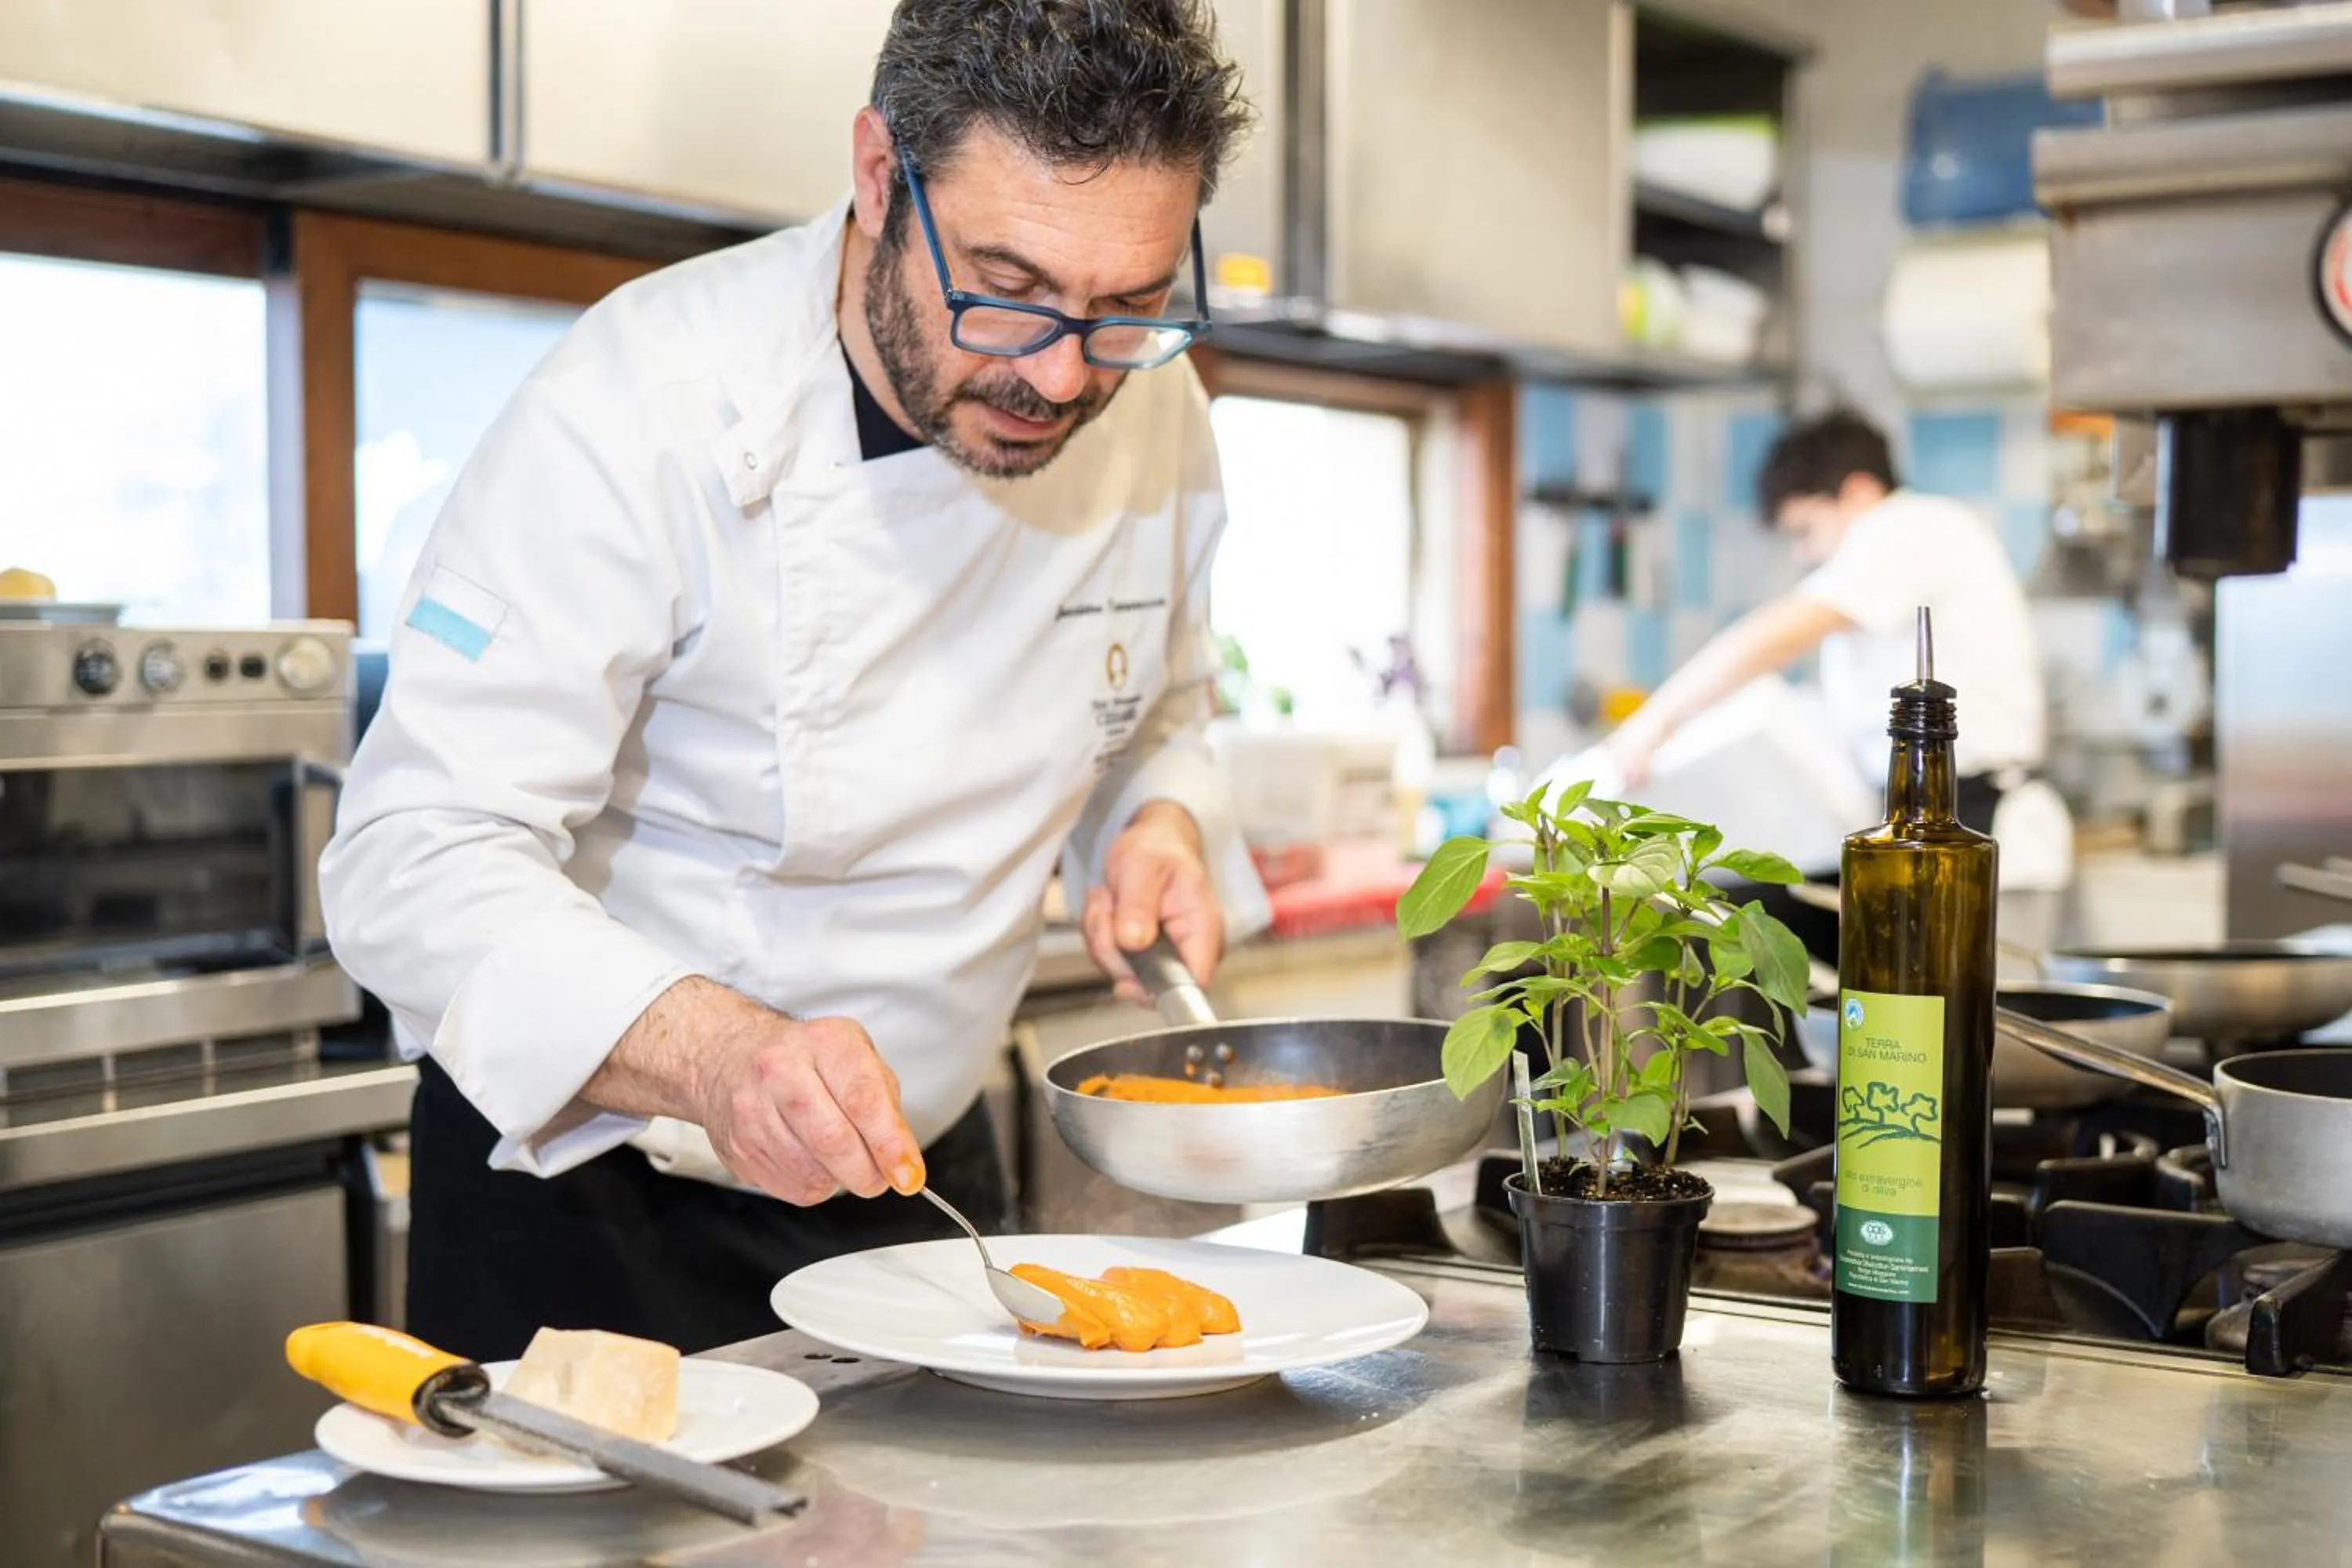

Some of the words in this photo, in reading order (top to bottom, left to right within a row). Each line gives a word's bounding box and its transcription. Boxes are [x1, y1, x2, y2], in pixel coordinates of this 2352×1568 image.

[1857, 1047, 1876, 1060] SAN
[1880, 1050, 1927, 1063] MARINO
[1859, 1173, 1923, 1189] extravergine
